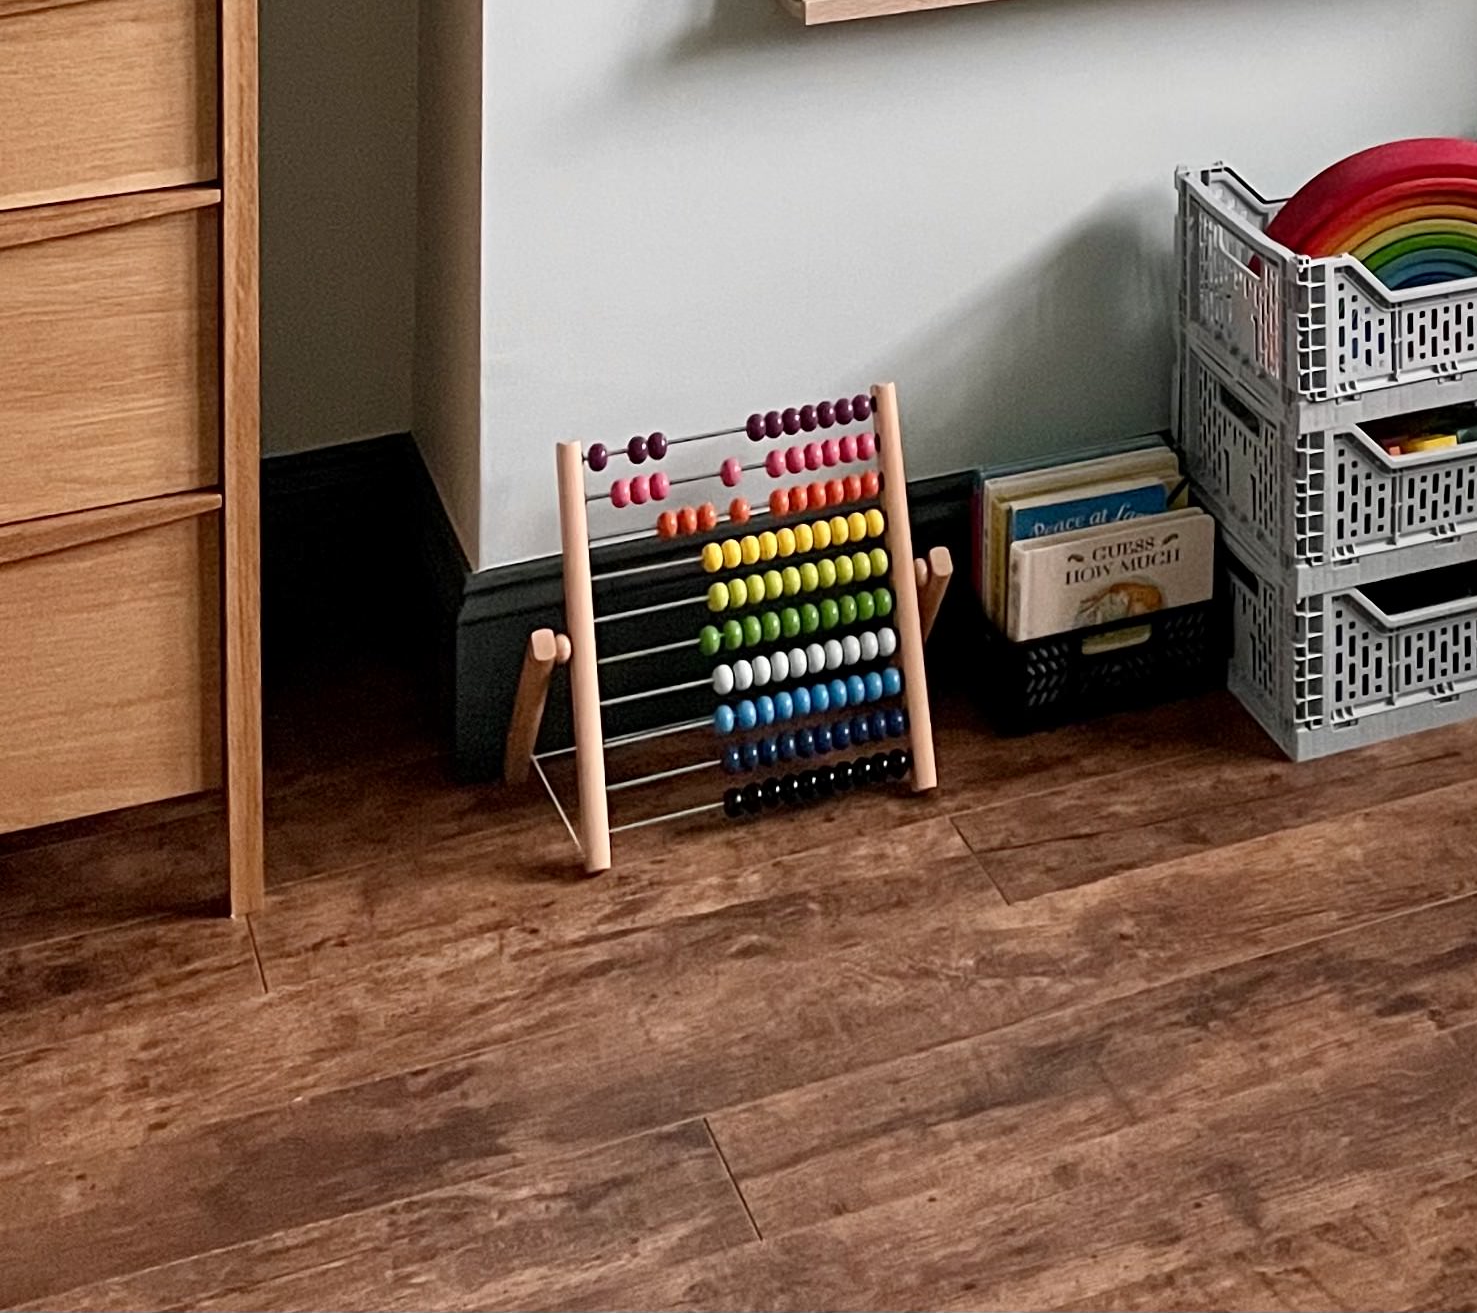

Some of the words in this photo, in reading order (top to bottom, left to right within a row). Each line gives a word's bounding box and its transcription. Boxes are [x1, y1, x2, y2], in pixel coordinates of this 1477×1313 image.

[1089, 508, 1109, 525] at
[1092, 536, 1155, 562] GUESS
[1065, 561, 1115, 586] HOW
[1119, 548, 1180, 573] MUCH
